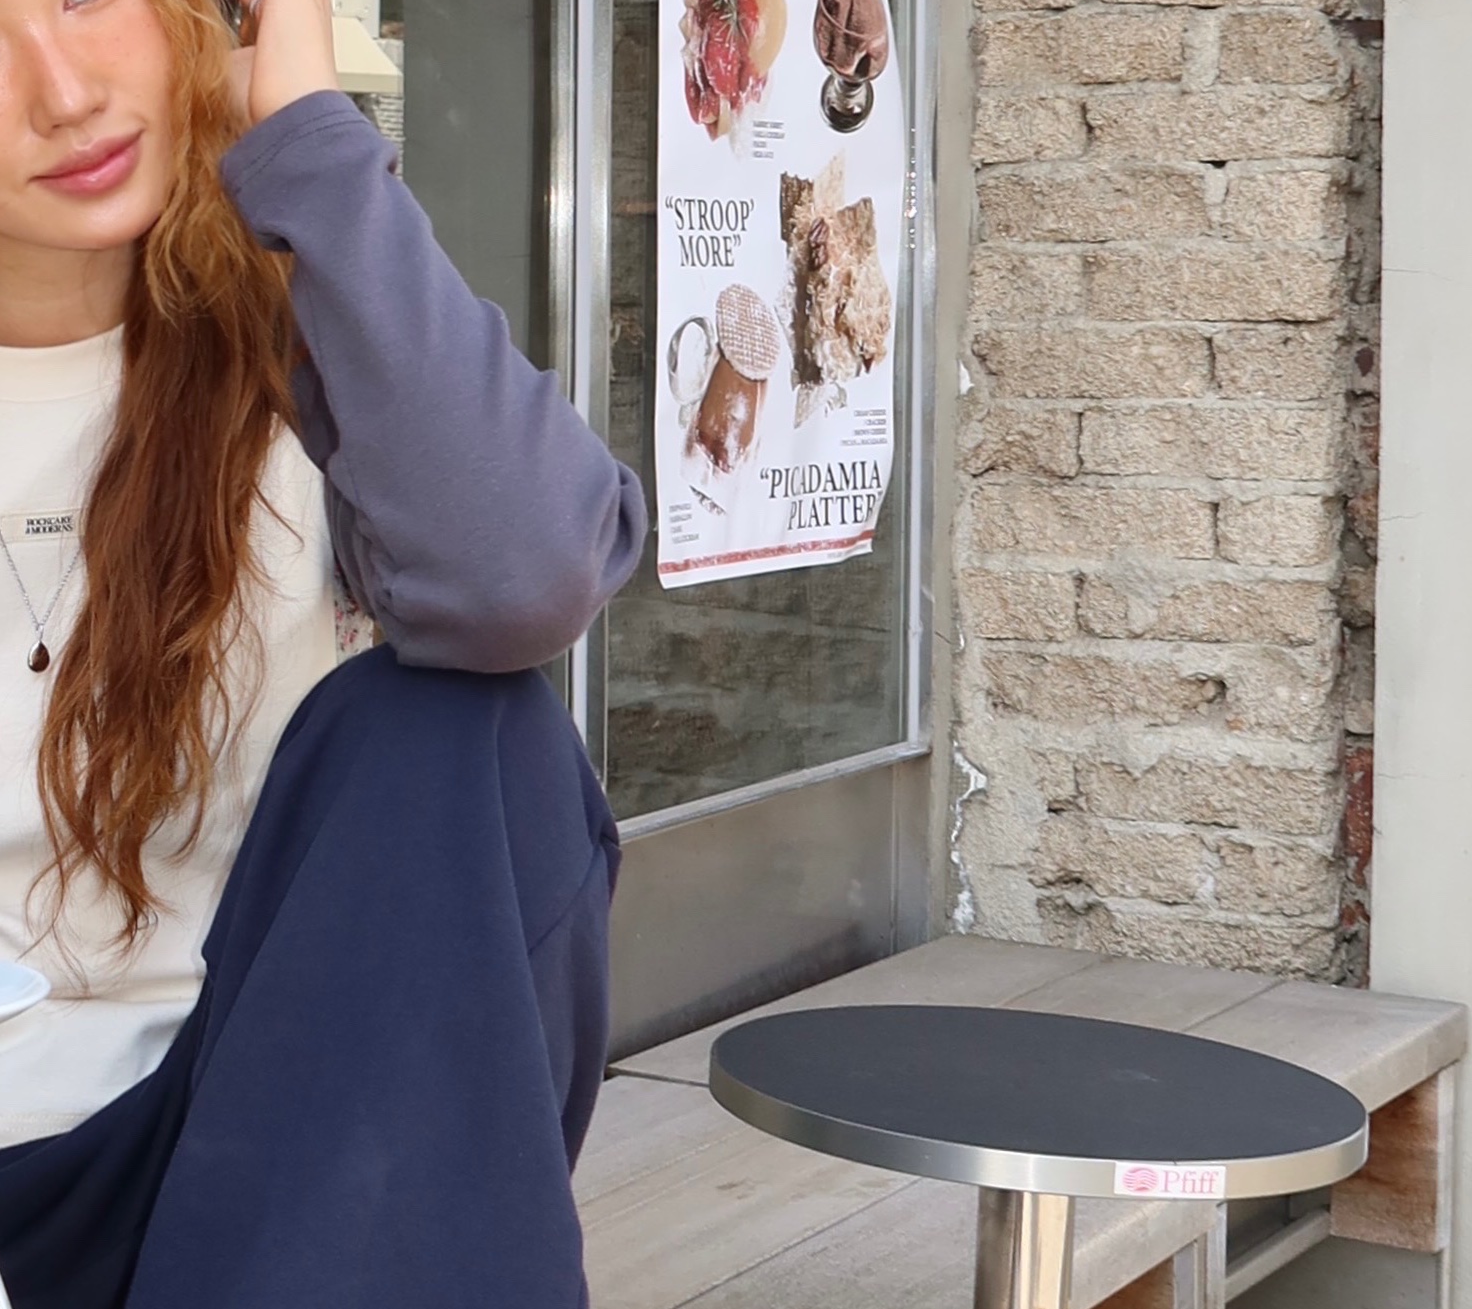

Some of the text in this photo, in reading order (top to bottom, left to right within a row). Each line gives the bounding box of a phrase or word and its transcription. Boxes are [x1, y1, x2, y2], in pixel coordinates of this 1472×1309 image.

[678, 233, 742, 268] MORE”
[759, 459, 883, 500] “PICADAMIA
[1160, 1169, 1220, 1195] Pfiff
